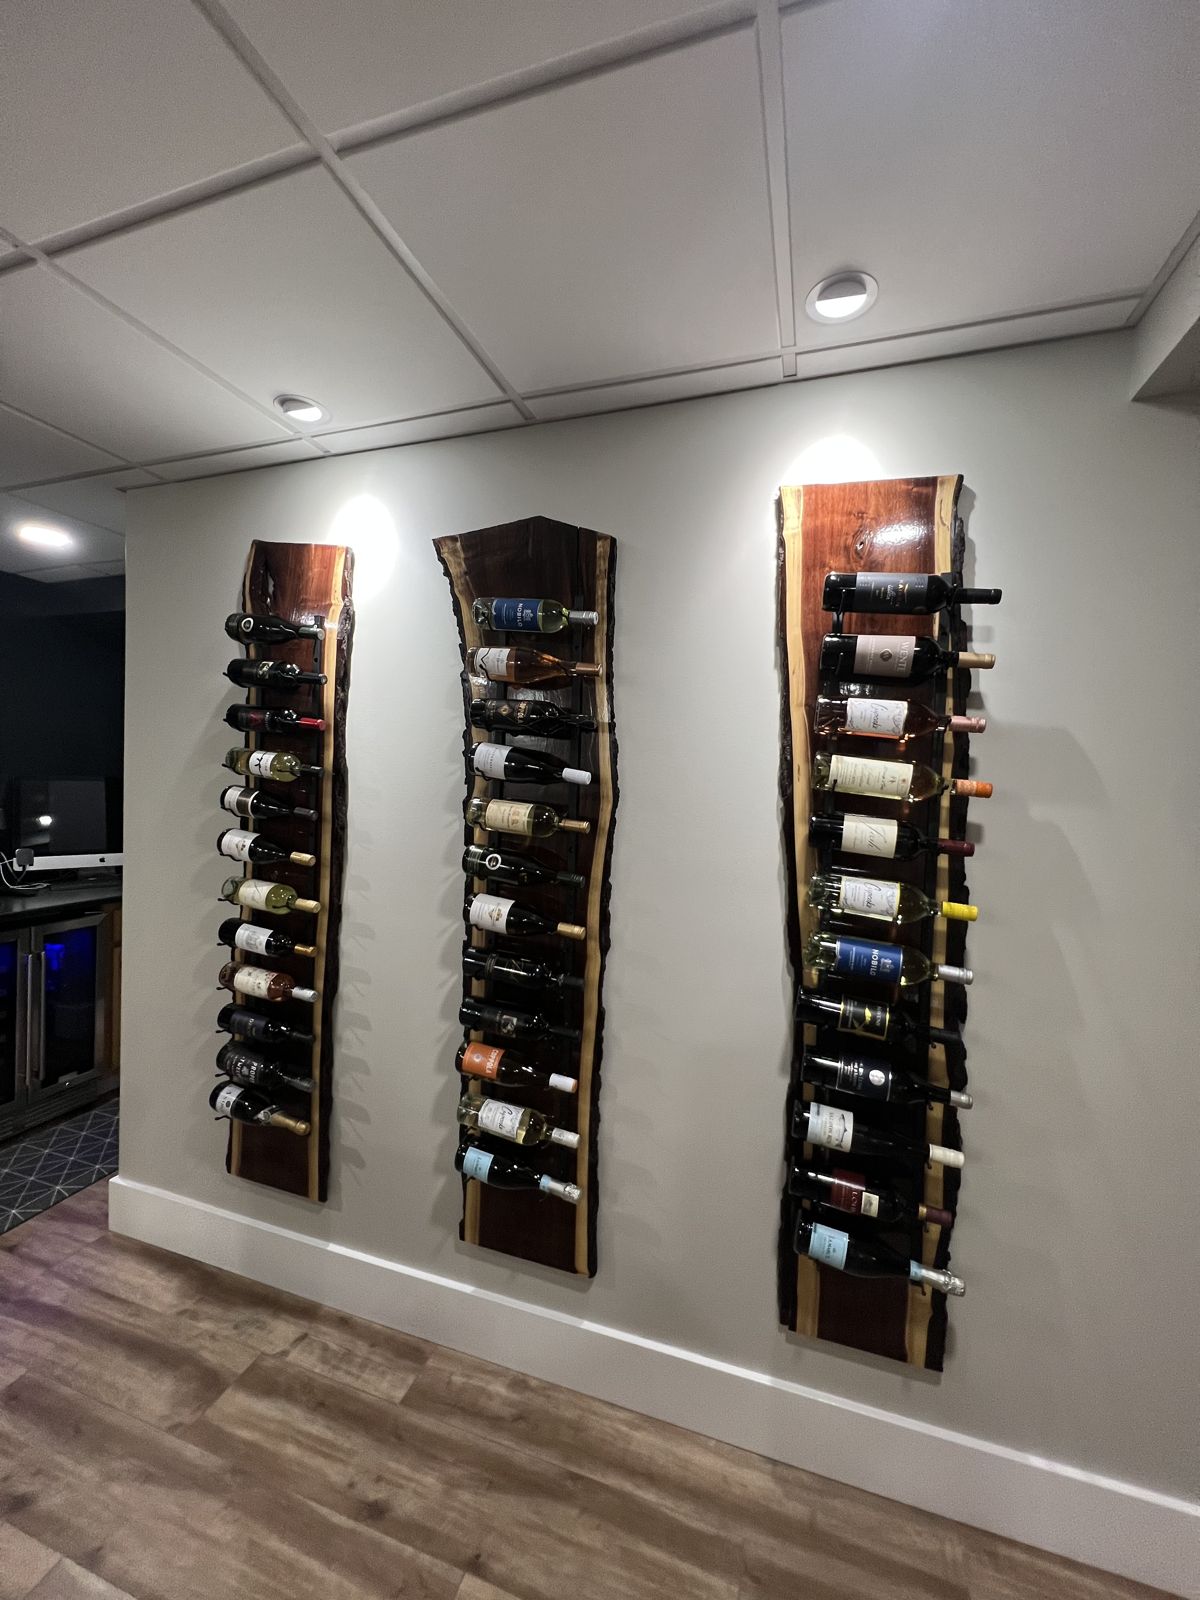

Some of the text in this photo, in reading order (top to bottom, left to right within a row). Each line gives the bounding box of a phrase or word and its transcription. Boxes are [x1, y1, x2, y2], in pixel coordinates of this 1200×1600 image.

[516, 603, 524, 628] NOBILO
[870, 702, 889, 729] Cupcake
[863, 881, 882, 909] Cupcake
[869, 948, 880, 976] NOBILO
[485, 1049, 499, 1074] COPPOLA
[497, 1104, 513, 1131] Cupcake
